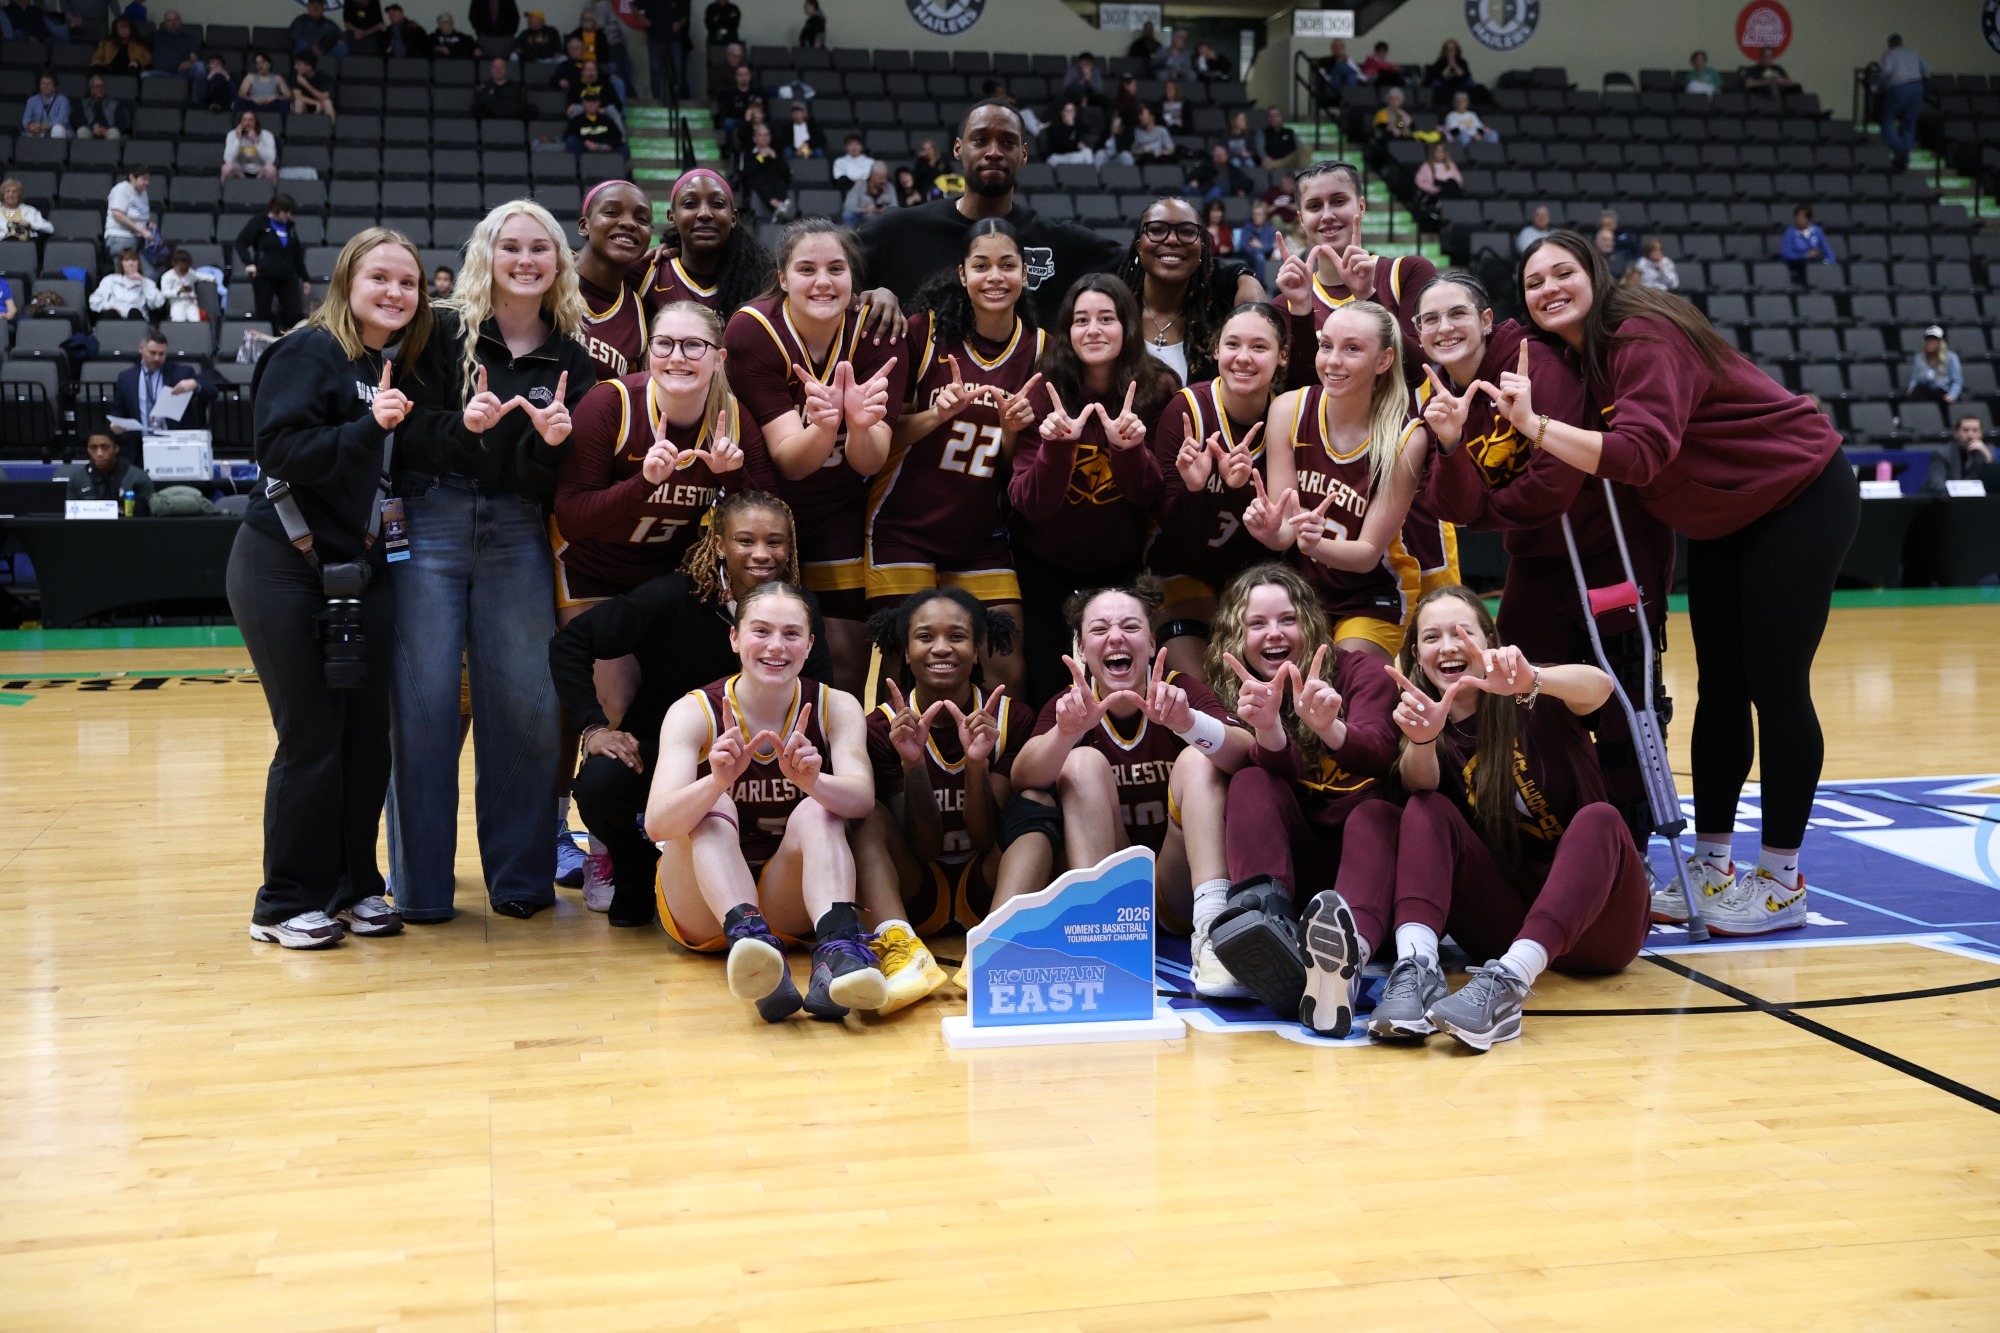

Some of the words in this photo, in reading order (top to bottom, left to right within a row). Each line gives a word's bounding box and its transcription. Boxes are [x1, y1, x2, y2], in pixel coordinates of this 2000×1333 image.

[939, 420, 1002, 478] 22
[629, 516, 689, 543] 13
[1117, 907, 1150, 922] 2026
[1064, 924, 1100, 935] WOMEN'S
[1102, 922, 1147, 934] BASKETBALL
[1067, 934, 1112, 943] TOURNAMENT
[1113, 932, 1147, 942] CHAMPION
[989, 965, 1105, 985] MOUNTAIN
[989, 981, 1104, 1014] EAST
